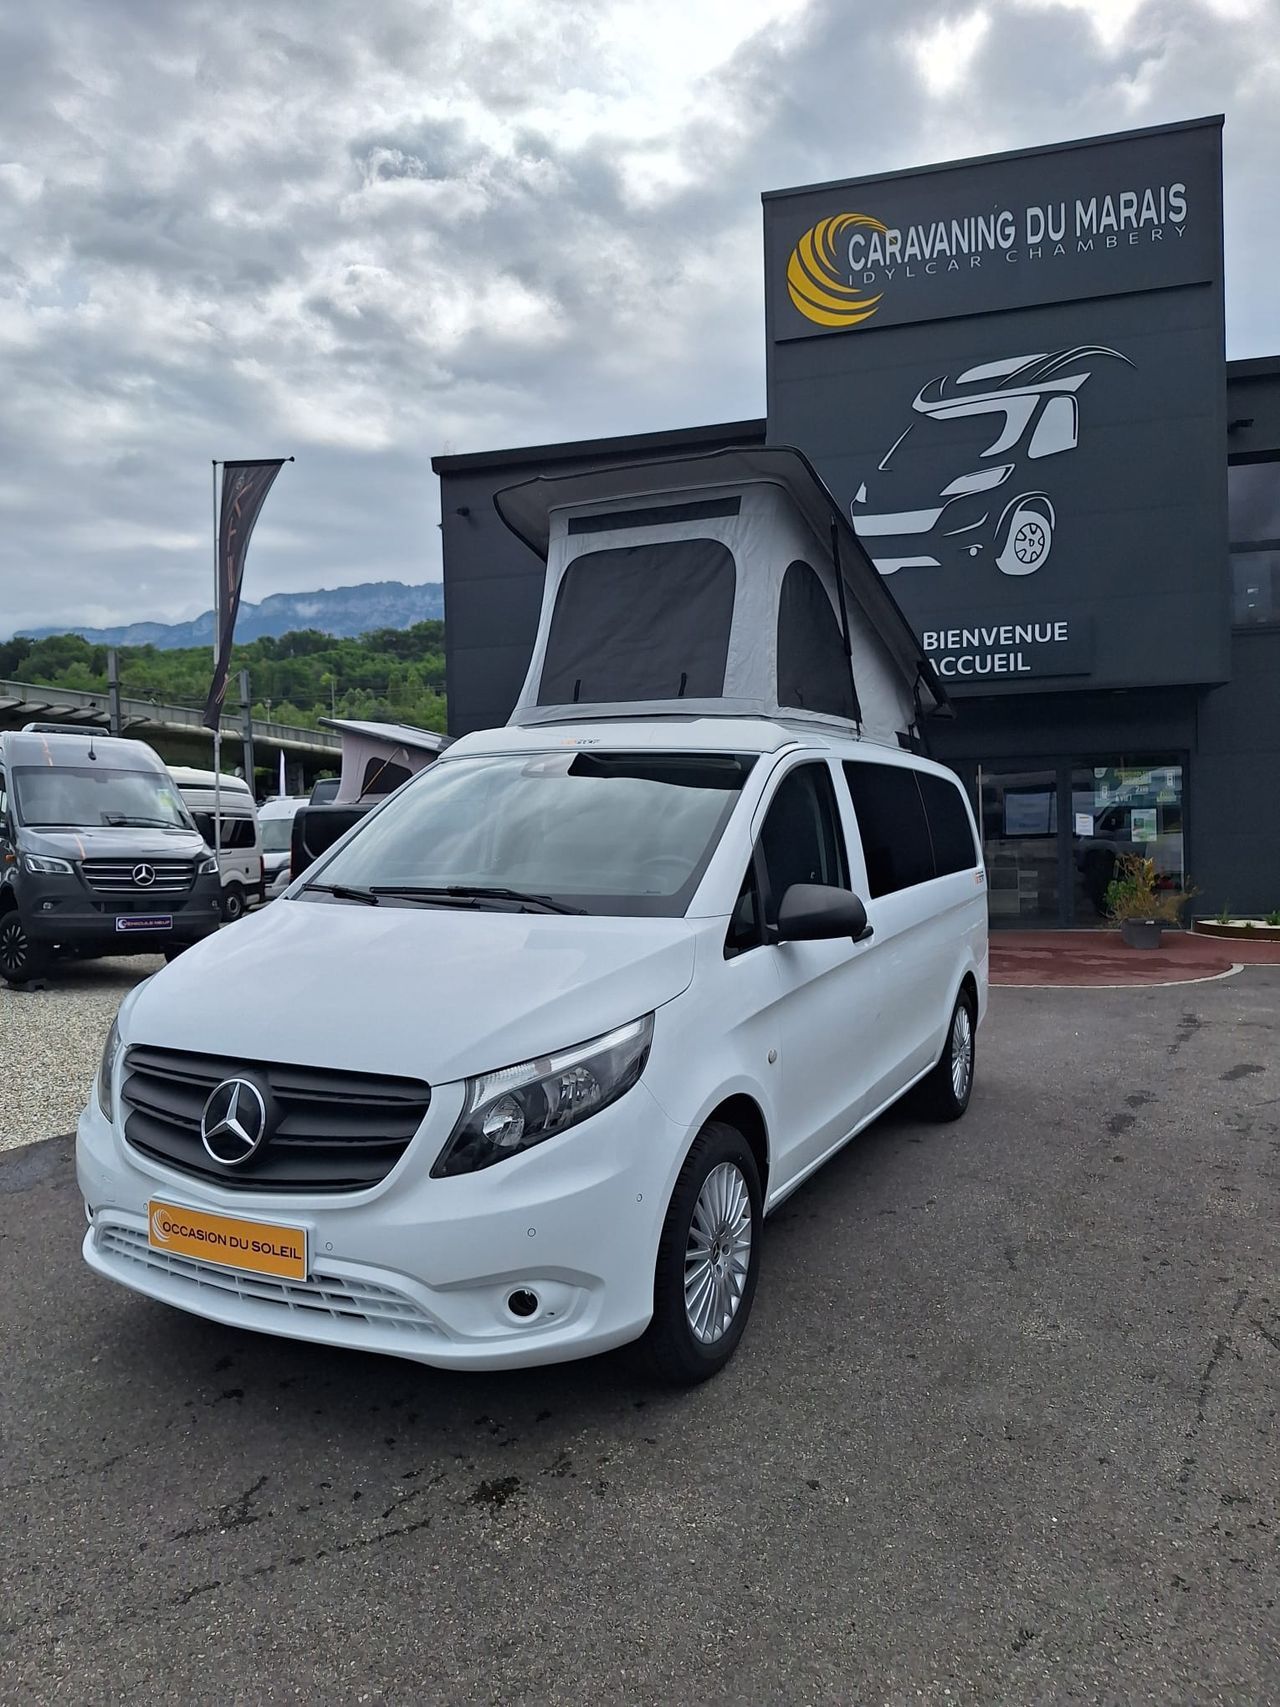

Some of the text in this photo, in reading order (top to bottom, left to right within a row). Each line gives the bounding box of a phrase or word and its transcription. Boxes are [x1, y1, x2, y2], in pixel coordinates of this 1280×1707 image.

[848, 183, 1187, 271] CARAVANING DU MARAIS
[849, 225, 1186, 286] IDYLCAR CHAMBERY
[923, 621, 1068, 650] BIENVENUE
[162, 1221, 302, 1260] OCCASION DU SOLEIL
